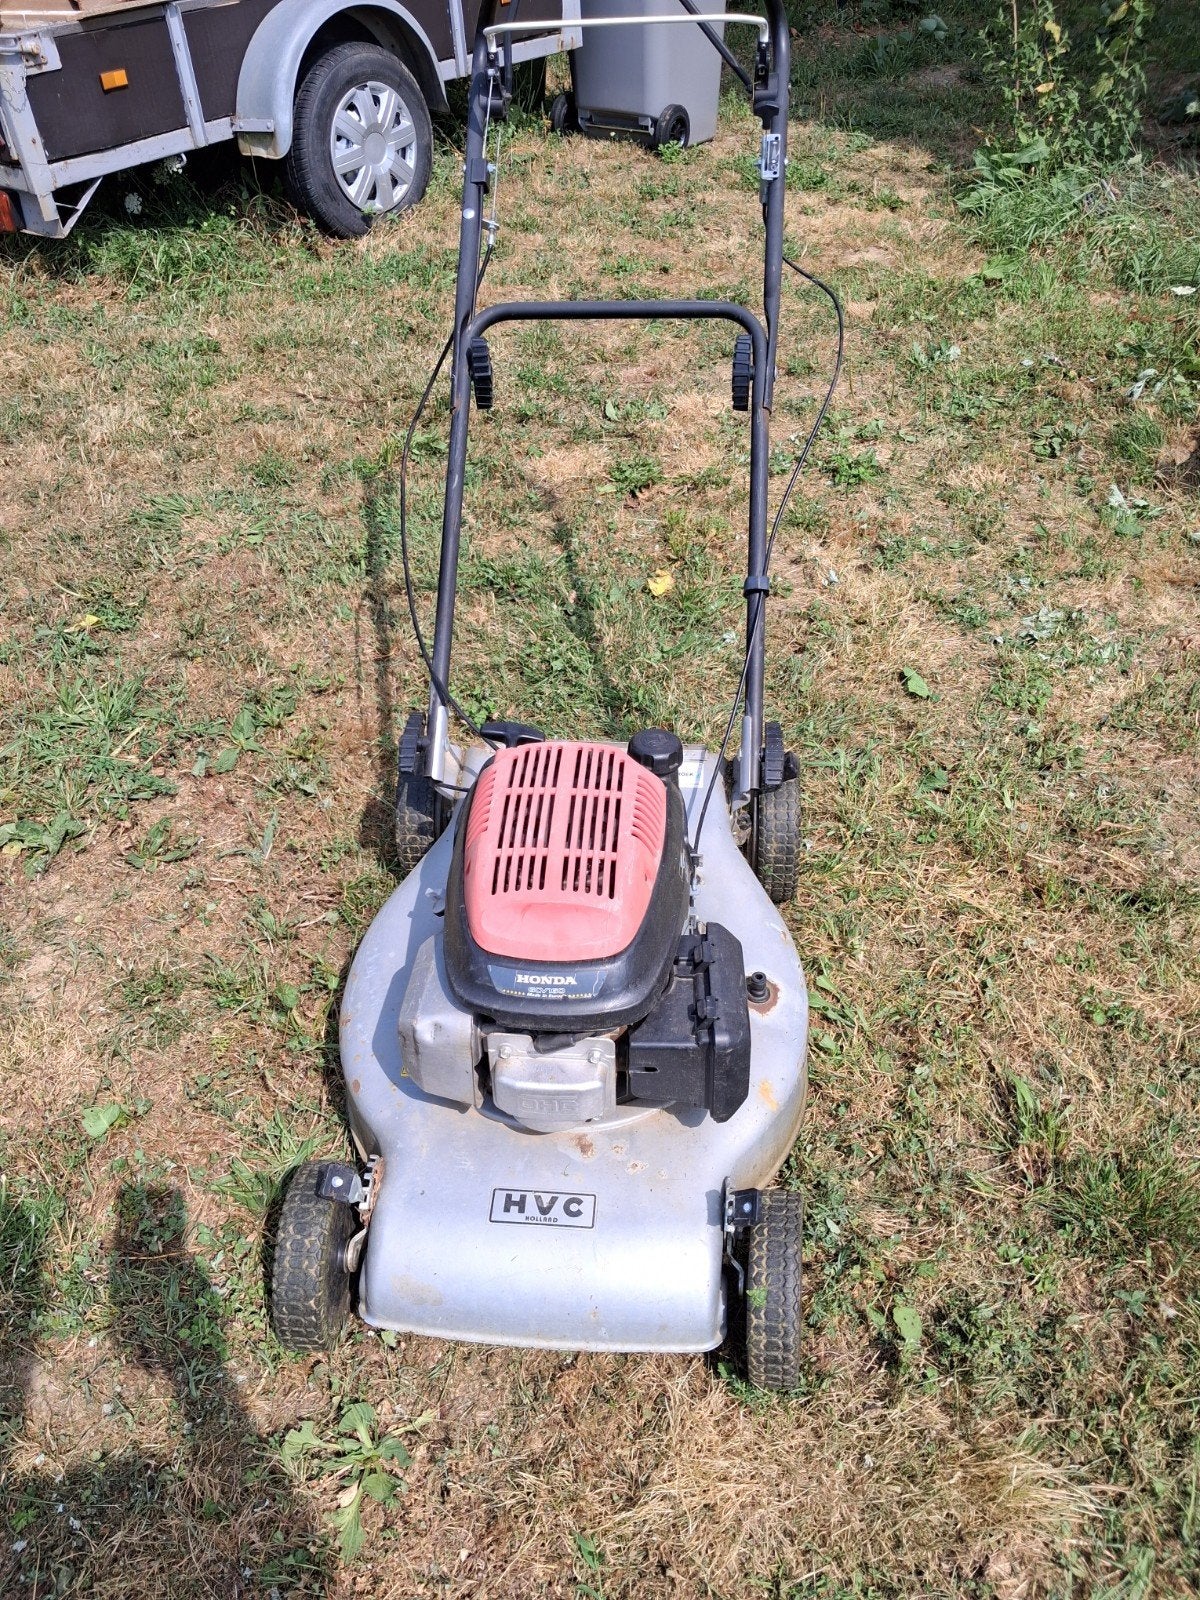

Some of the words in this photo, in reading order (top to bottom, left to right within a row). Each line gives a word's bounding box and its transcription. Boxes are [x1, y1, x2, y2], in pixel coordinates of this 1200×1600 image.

[516, 974, 577, 985] HONDA
[503, 1193, 584, 1218] HVC
[525, 1215, 559, 1223] HOLLAND
